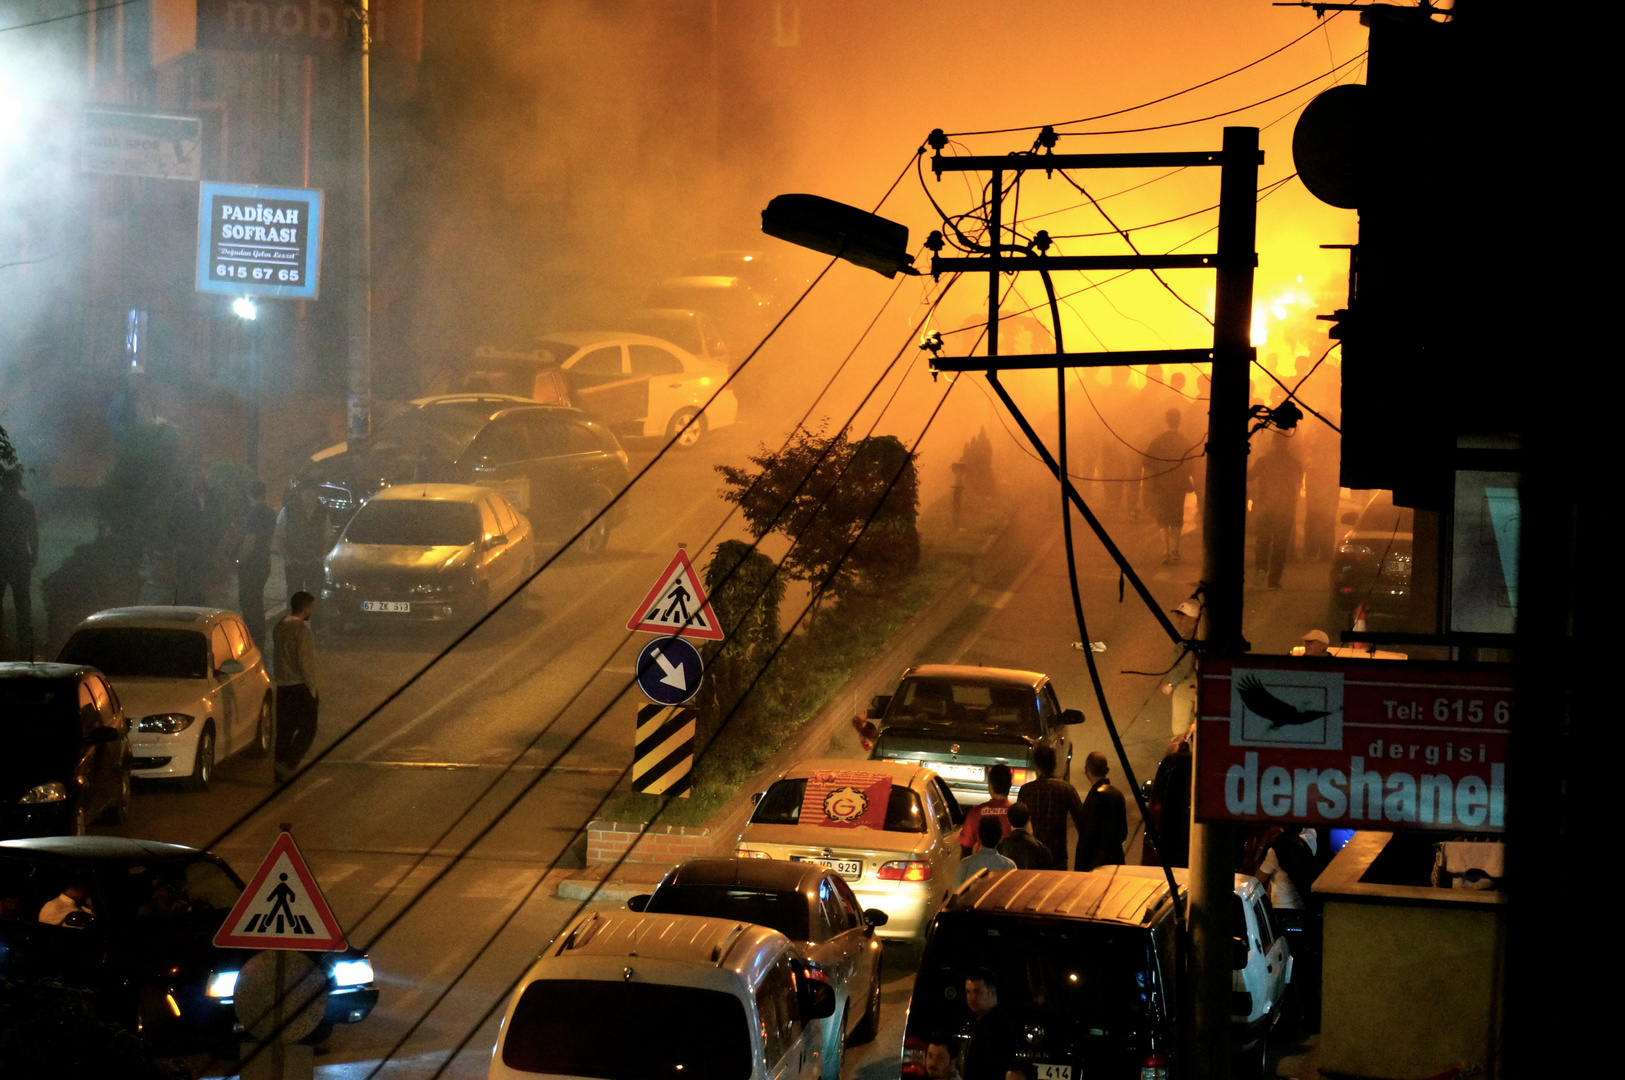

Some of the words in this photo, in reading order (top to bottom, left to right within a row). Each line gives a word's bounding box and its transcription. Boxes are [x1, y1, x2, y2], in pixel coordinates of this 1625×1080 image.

[222, 203, 299, 225] PADİŞAH
[222, 223, 297, 243] SOFRASI
[216, 264, 247, 278] 615
[252, 267, 273, 280] 67
[278, 269, 299, 281] 65
[1384, 699, 1424, 721] Tel:
[1434, 698, 1484, 723] 615
[1493, 701, 1512, 724] 6
[1368, 740, 1487, 765] dergisi
[838, 862, 858, 873] 929
[1045, 1066, 1069, 1080] 414
